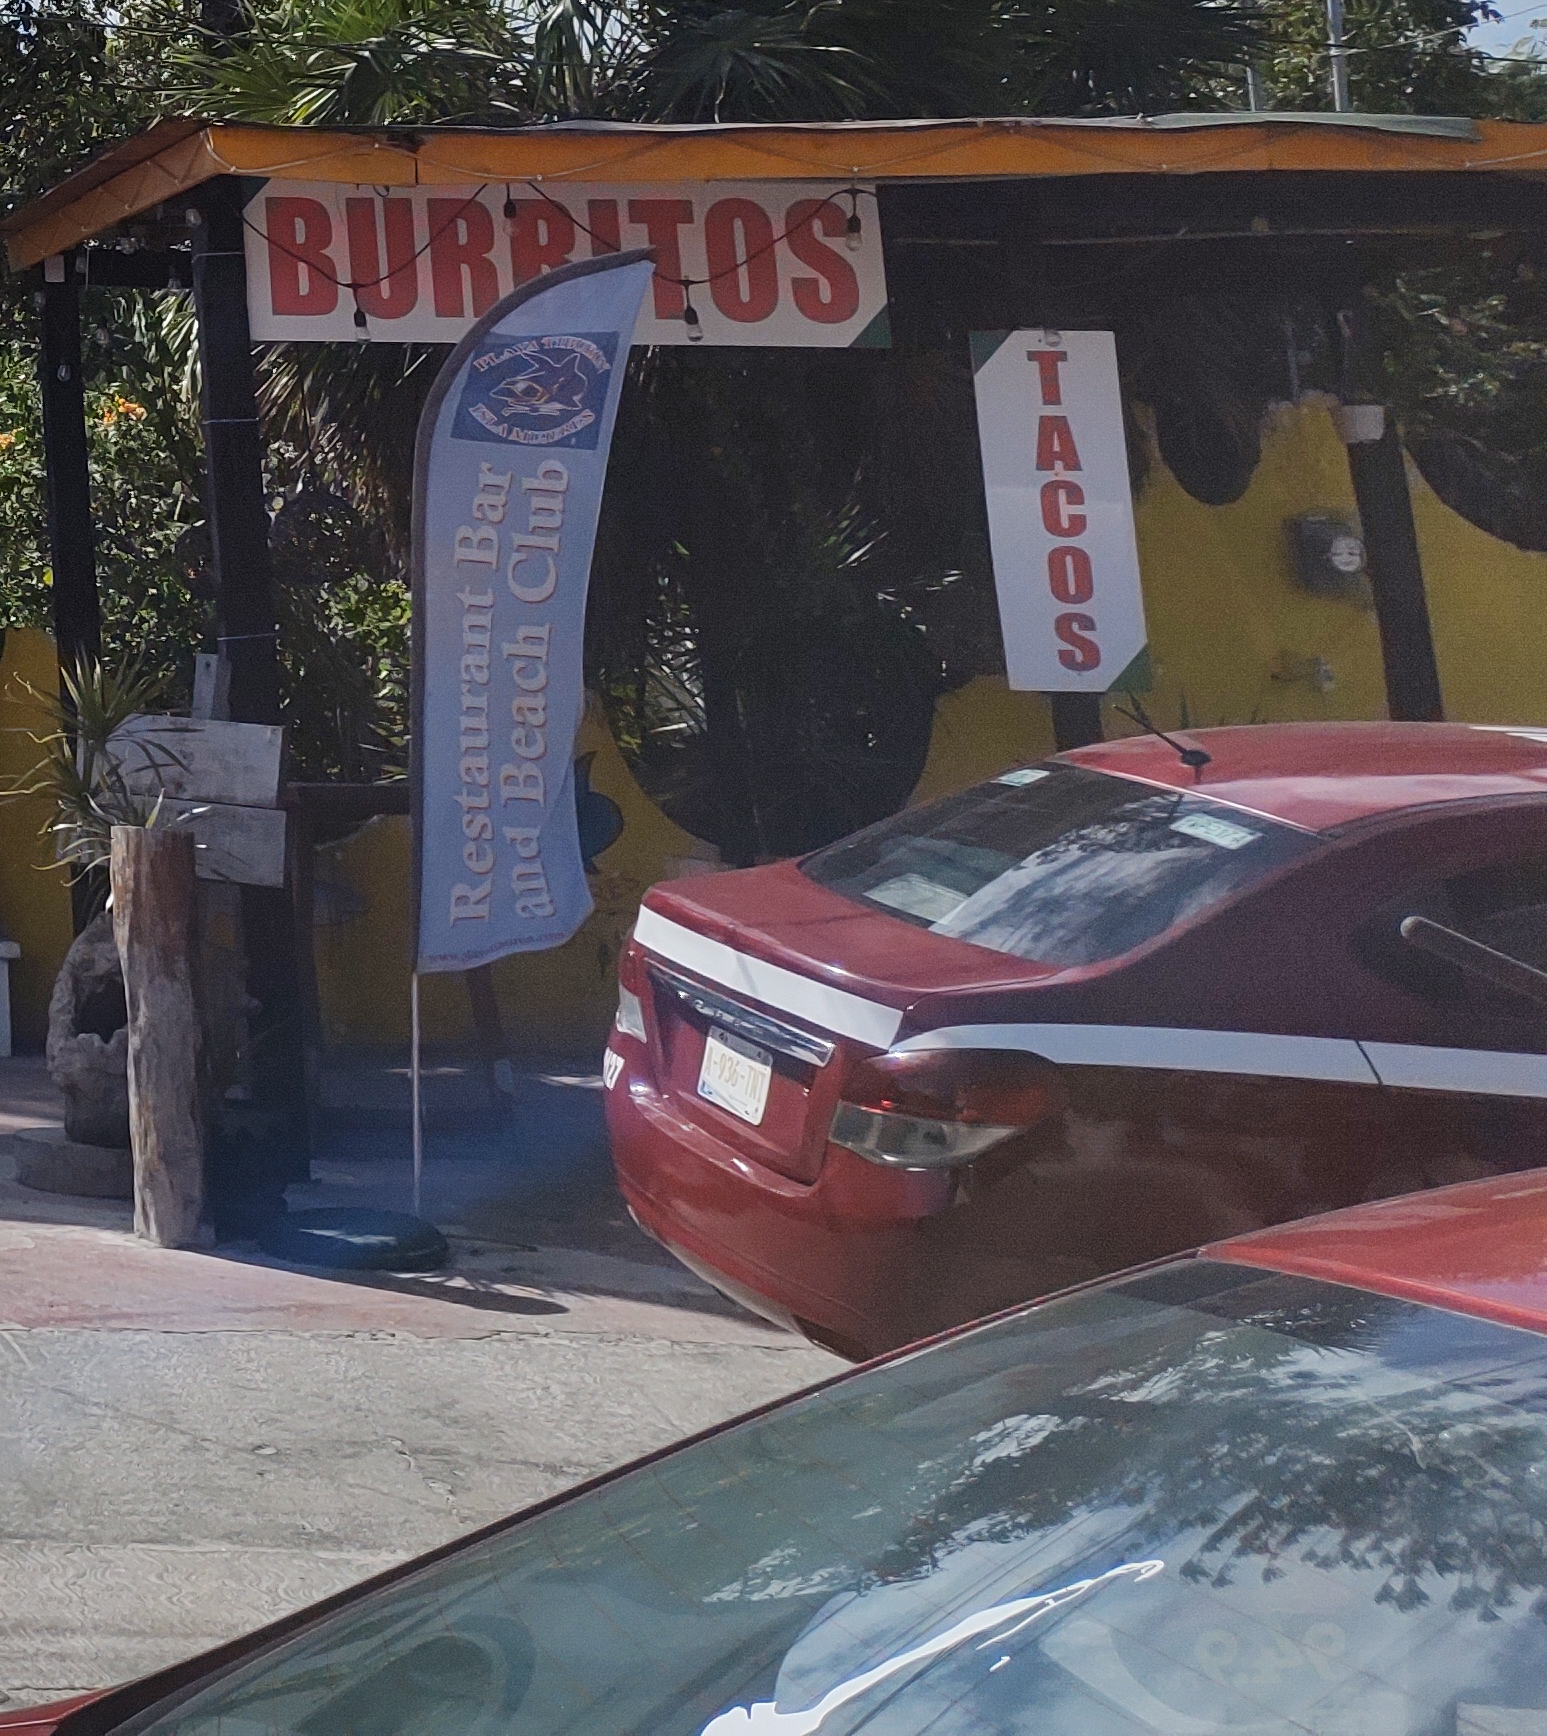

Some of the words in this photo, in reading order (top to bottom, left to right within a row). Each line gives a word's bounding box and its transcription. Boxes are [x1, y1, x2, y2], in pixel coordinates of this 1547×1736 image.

[454, 461, 512, 570] Bar
[508, 457, 569, 604] Club
[1026, 350, 1101, 671] TACOS
[449, 584, 495, 928] Restaurant
[500, 621, 552, 808] Beach
[502, 822, 557, 921] and
